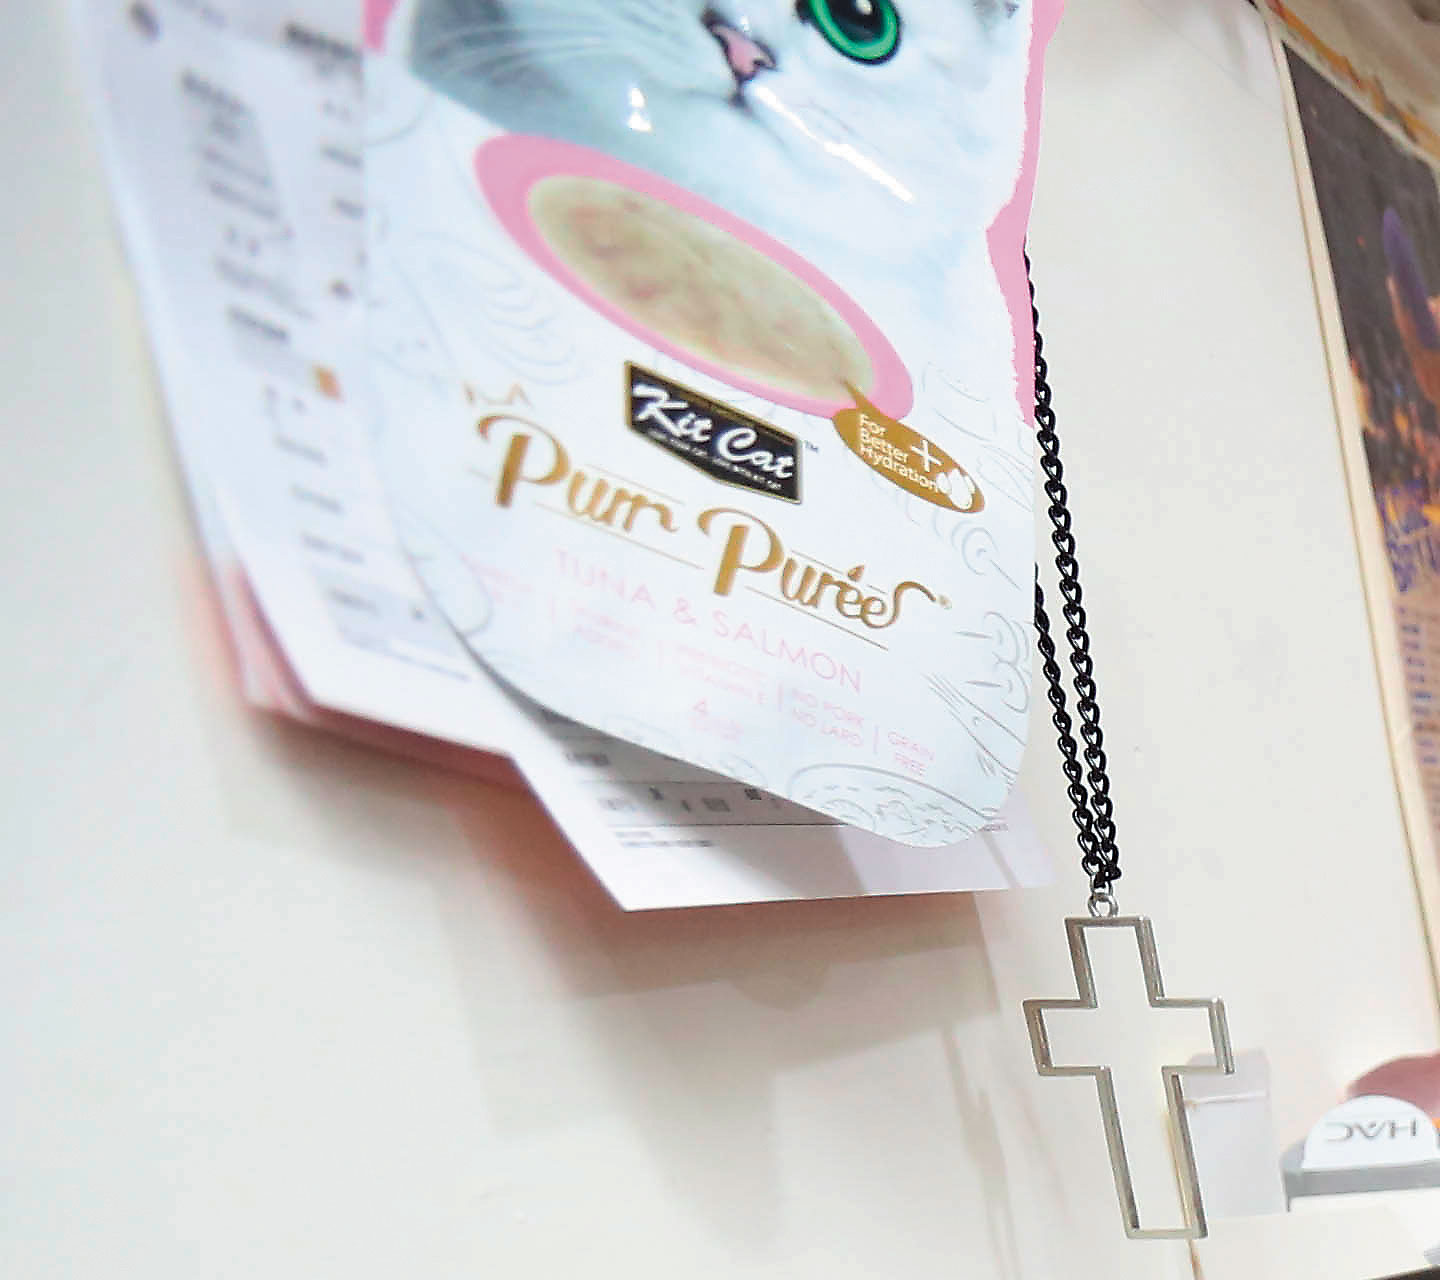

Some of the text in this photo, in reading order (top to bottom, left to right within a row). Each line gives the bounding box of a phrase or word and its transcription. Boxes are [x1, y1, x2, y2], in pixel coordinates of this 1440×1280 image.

[632, 384, 712, 442] Kit
[716, 427, 794, 479] Cat
[860, 414, 887, 435] For
[860, 430, 910, 464] Better
[860, 446, 939, 493] Hydration
[712, 609, 862, 694] SALMON
